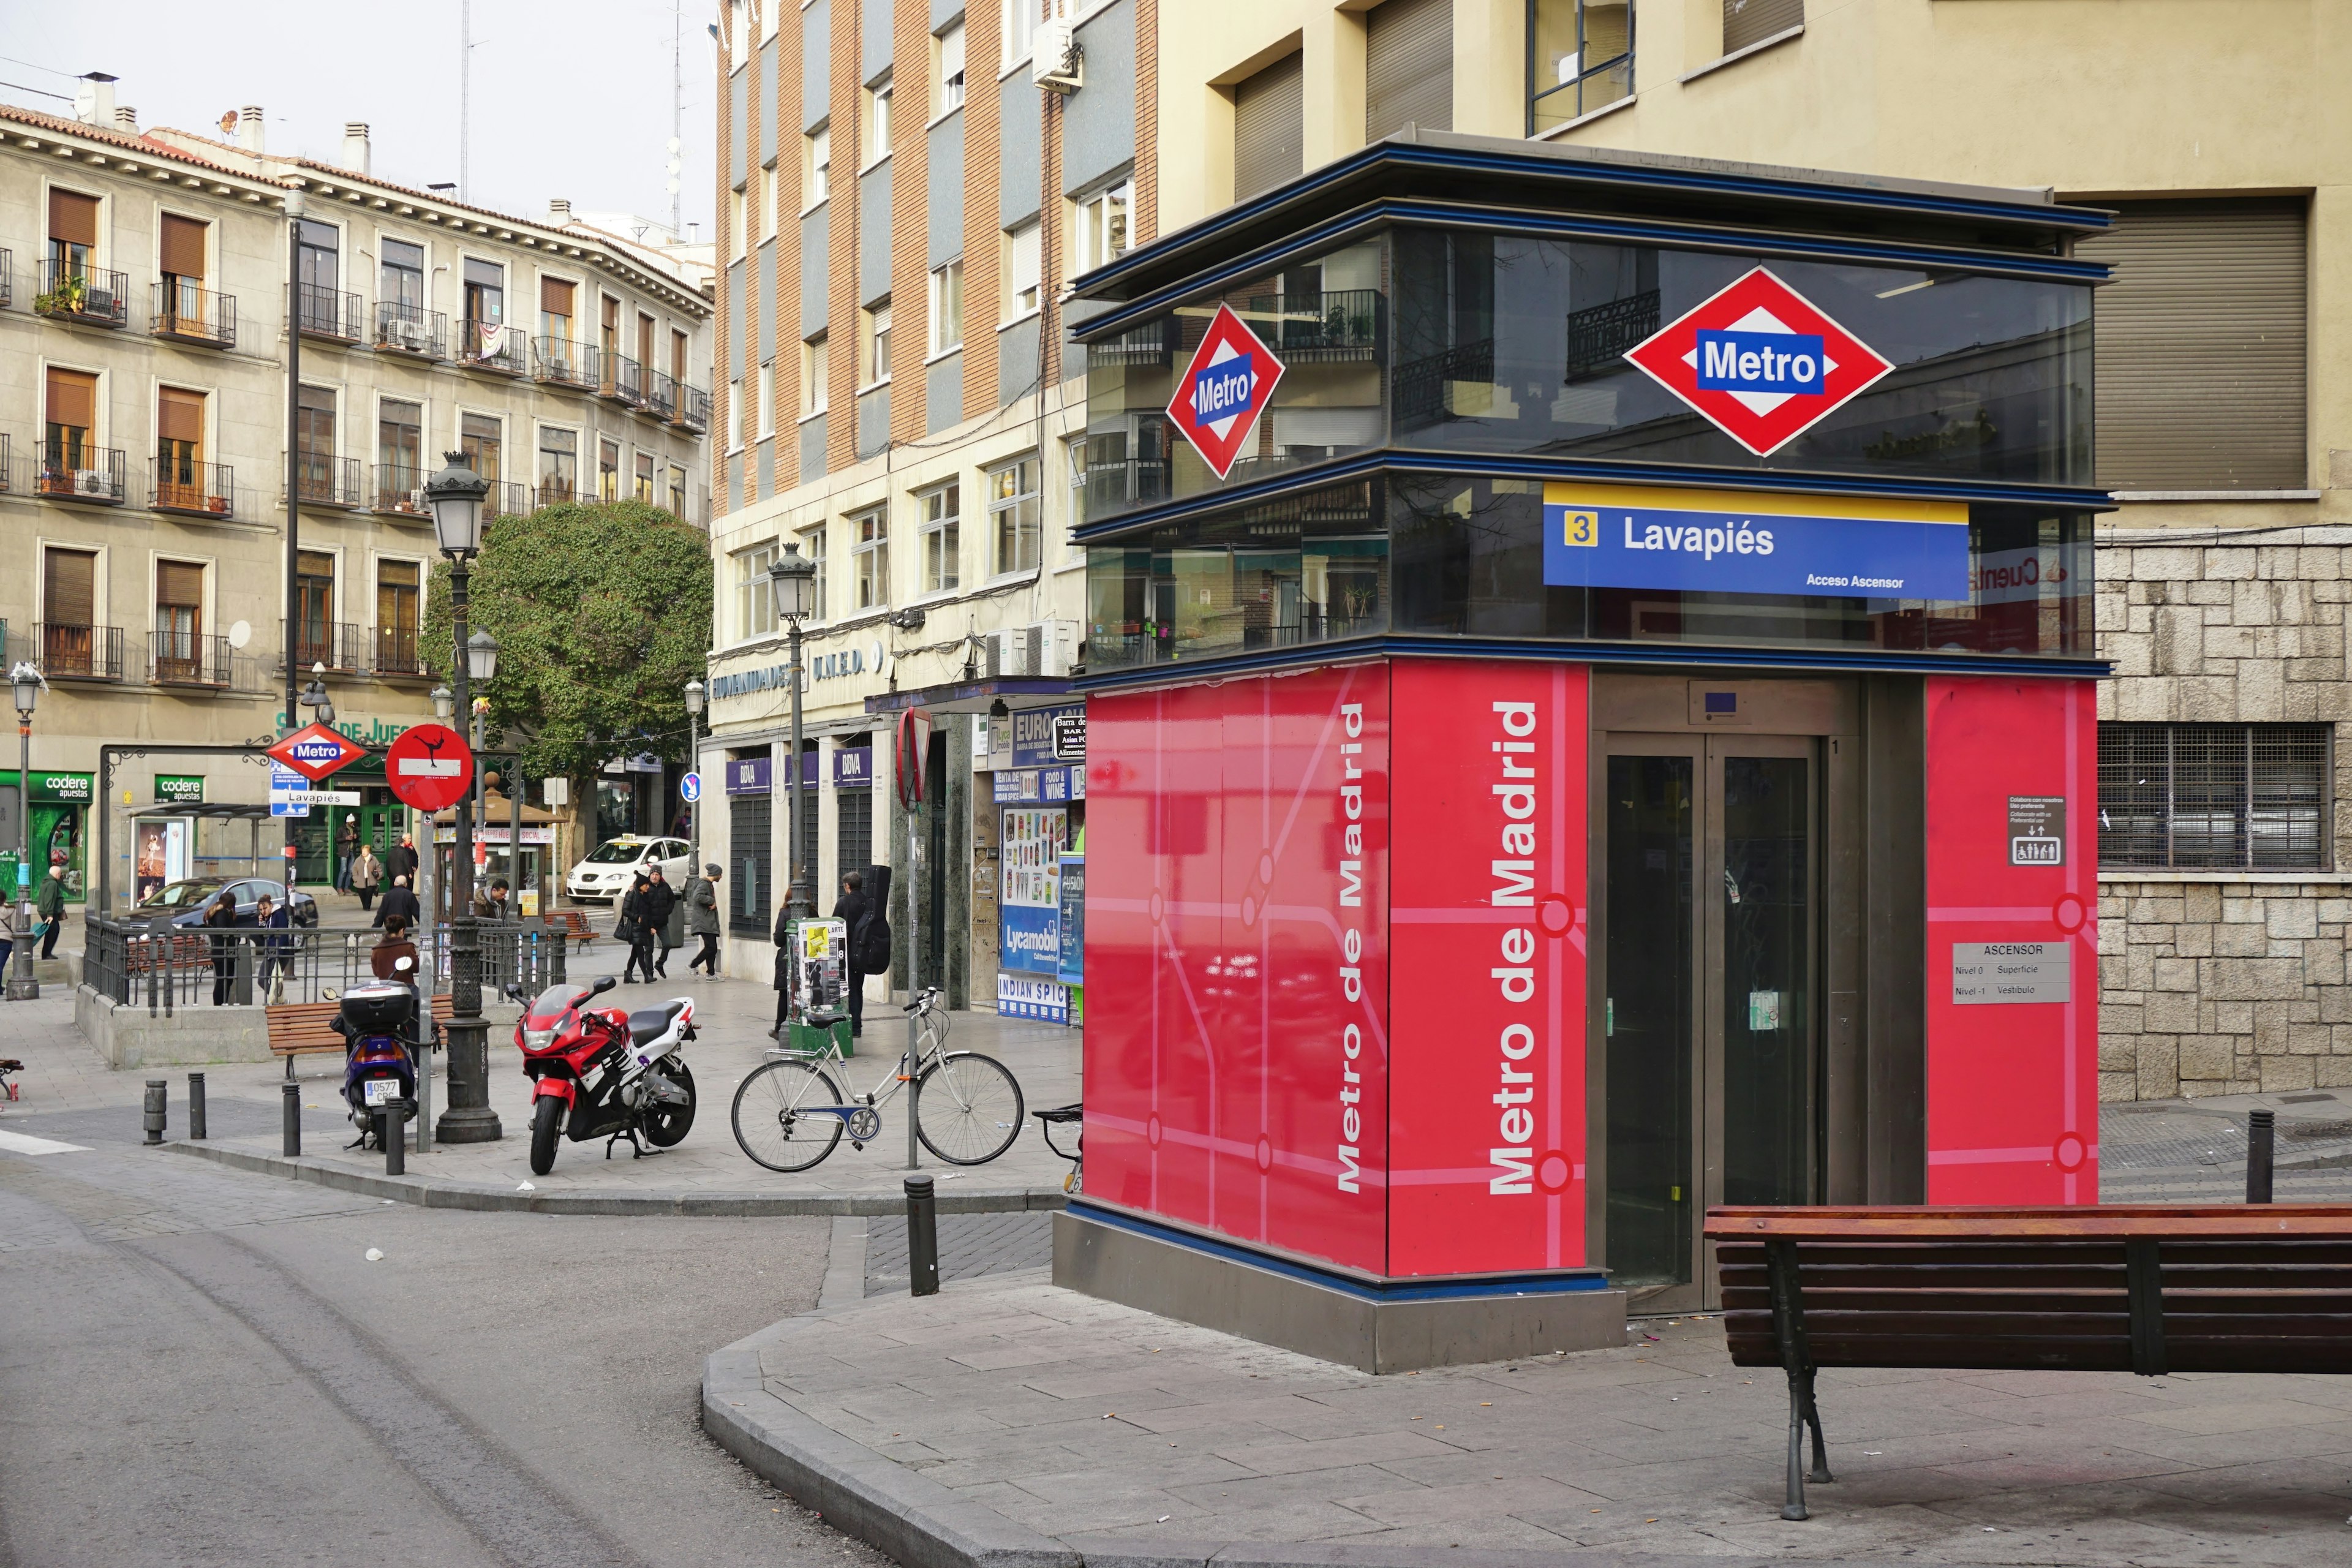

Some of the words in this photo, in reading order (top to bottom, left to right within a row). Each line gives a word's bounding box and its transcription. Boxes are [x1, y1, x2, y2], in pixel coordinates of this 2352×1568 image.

[1705, 341, 1816, 383] Metro
[1199, 374, 1248, 415] Metro
[1573, 516, 1590, 542] 3
[1625, 516, 1774, 560] Lavapiés
[1806, 573, 1848, 586] Acceso
[1850, 575, 1904, 589] Ascensor
[712, 662, 792, 699] HUMANIDADES
[813, 649, 866, 681] U.N.E.D.
[339, 723, 362, 741] DE
[999, 728, 1010, 742] Lyca
[1017, 712, 1051, 742] EURO
[298, 745, 337, 757] Metro
[998, 741, 1010, 749] mobile
[842, 753, 861, 775] BBVA
[46, 775, 88, 789] codere
[740, 764, 755, 784] BBVA
[996, 772, 1011, 783] VENTA
[1012, 772, 1019, 782] DE
[1046, 772, 1059, 783] FOOD
[1060, 771, 1065, 782] &
[162, 778, 200, 792] codere
[1046, 783, 1065, 800] WINE
[59, 790, 88, 799] apuestas
[174, 793, 200, 801] apuestas
[289, 793, 341, 803] Lavapiés
[1340, 703, 1363, 907] Madrid
[1491, 701, 1537, 907] Madrid
[499, 829, 510, 839] HUE
[522, 831, 540, 841] SOCIAL
[839, 950, 844, 959] 8
[1984, 945, 2043, 956] ASCENSOR
[1338, 929, 1361, 1003] de
[1491, 929, 1536, 1003] de
[1956, 966, 1977, 974] Nivel
[1997, 965, 2038, 975] Superficie
[999, 979, 1031, 999] INDIAN
[1036, 982, 1067, 1003] SPIC
[1956, 987, 1977, 995] Nivel
[374, 1082, 396, 1092] 0577
[1338, 1023, 1361, 1194] Metro
[1490, 1023, 1535, 1196] Metro
